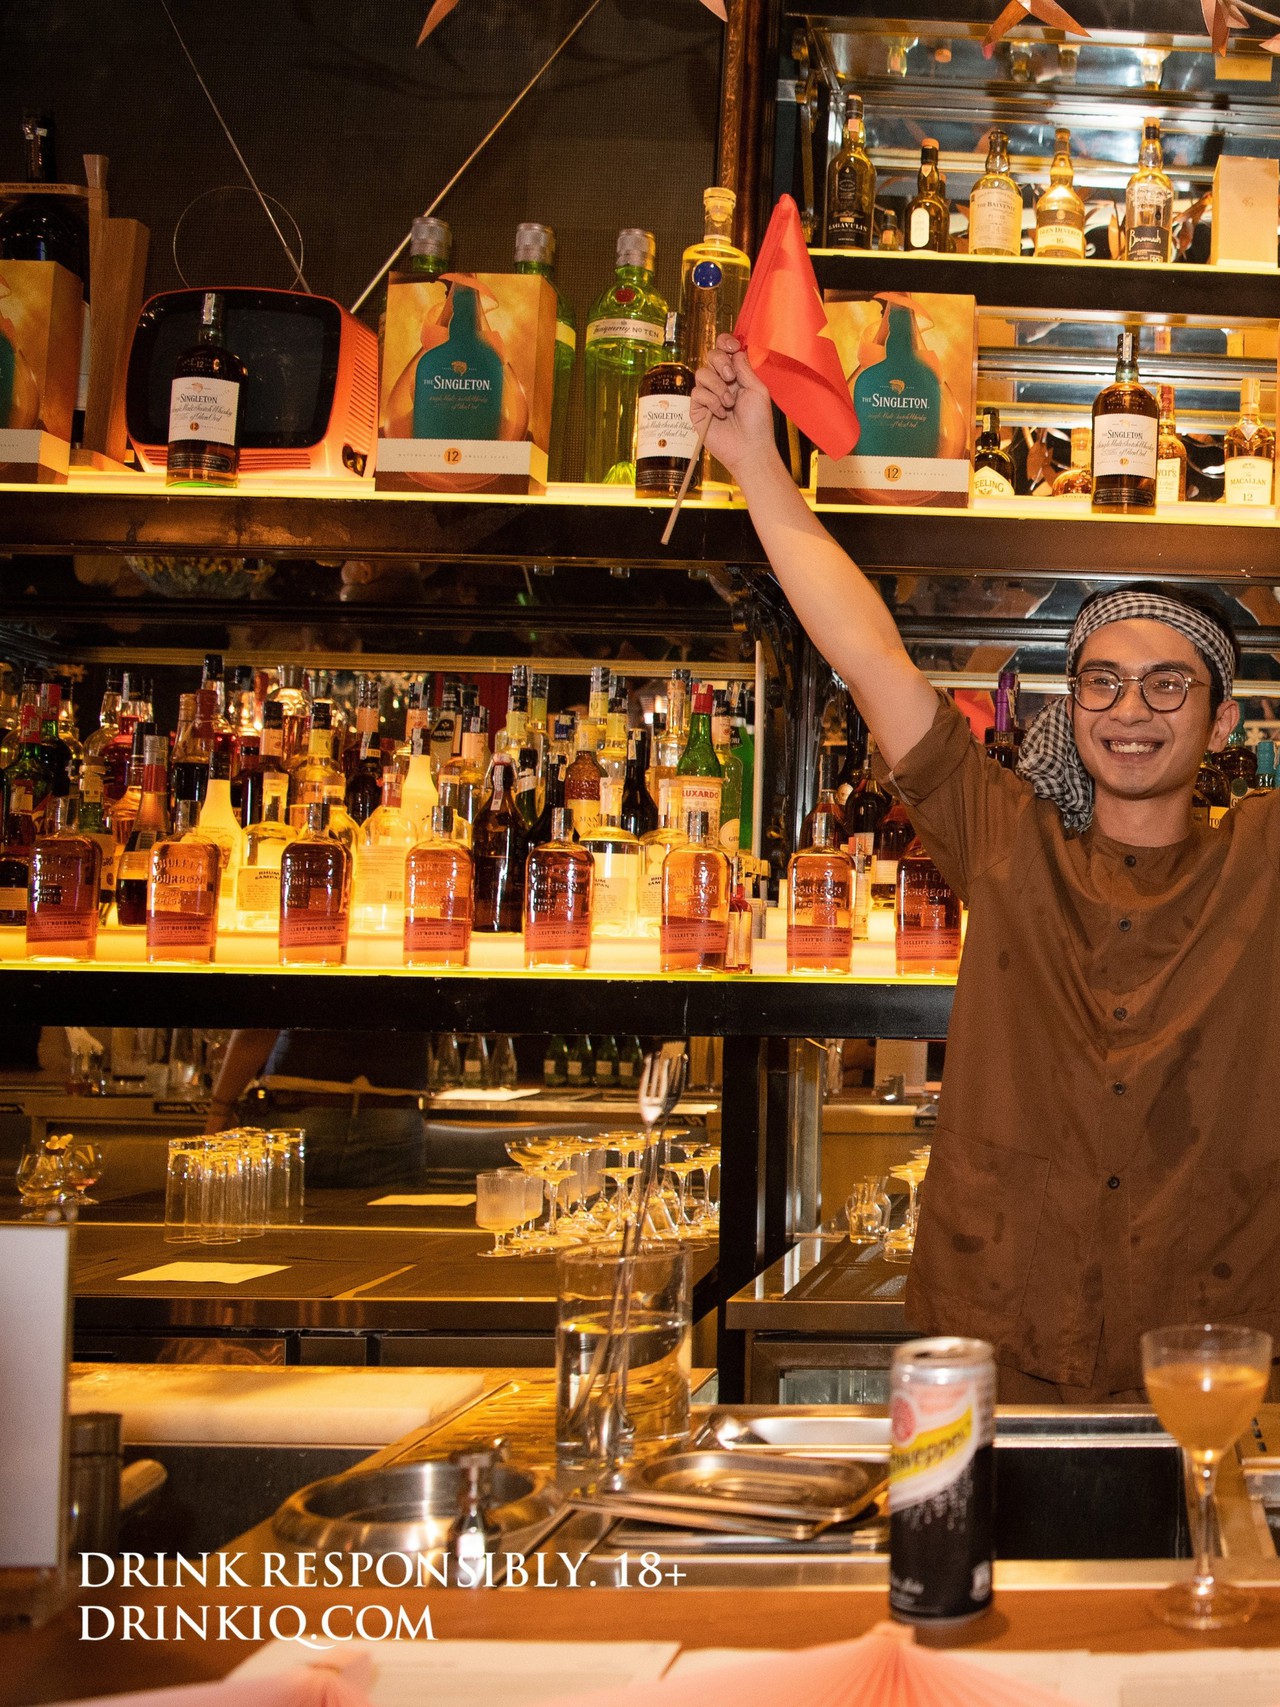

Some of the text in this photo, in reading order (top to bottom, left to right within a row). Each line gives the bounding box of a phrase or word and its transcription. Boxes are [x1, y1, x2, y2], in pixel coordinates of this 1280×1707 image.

[828, 222, 869, 232] LAGAVULIN
[644, 329, 660, 339] TEN
[180, 393, 218, 404] SINGLETON
[647, 411, 683, 421] SINGLETON
[1107, 429, 1143, 440] SINGLETON
[447, 451, 459, 462] 12
[887, 468, 899, 479] 12
[975, 479, 1005, 493] EELING
[1230, 477, 1267, 486] MACALLAN
[681, 790, 720, 800] LUXARDO
